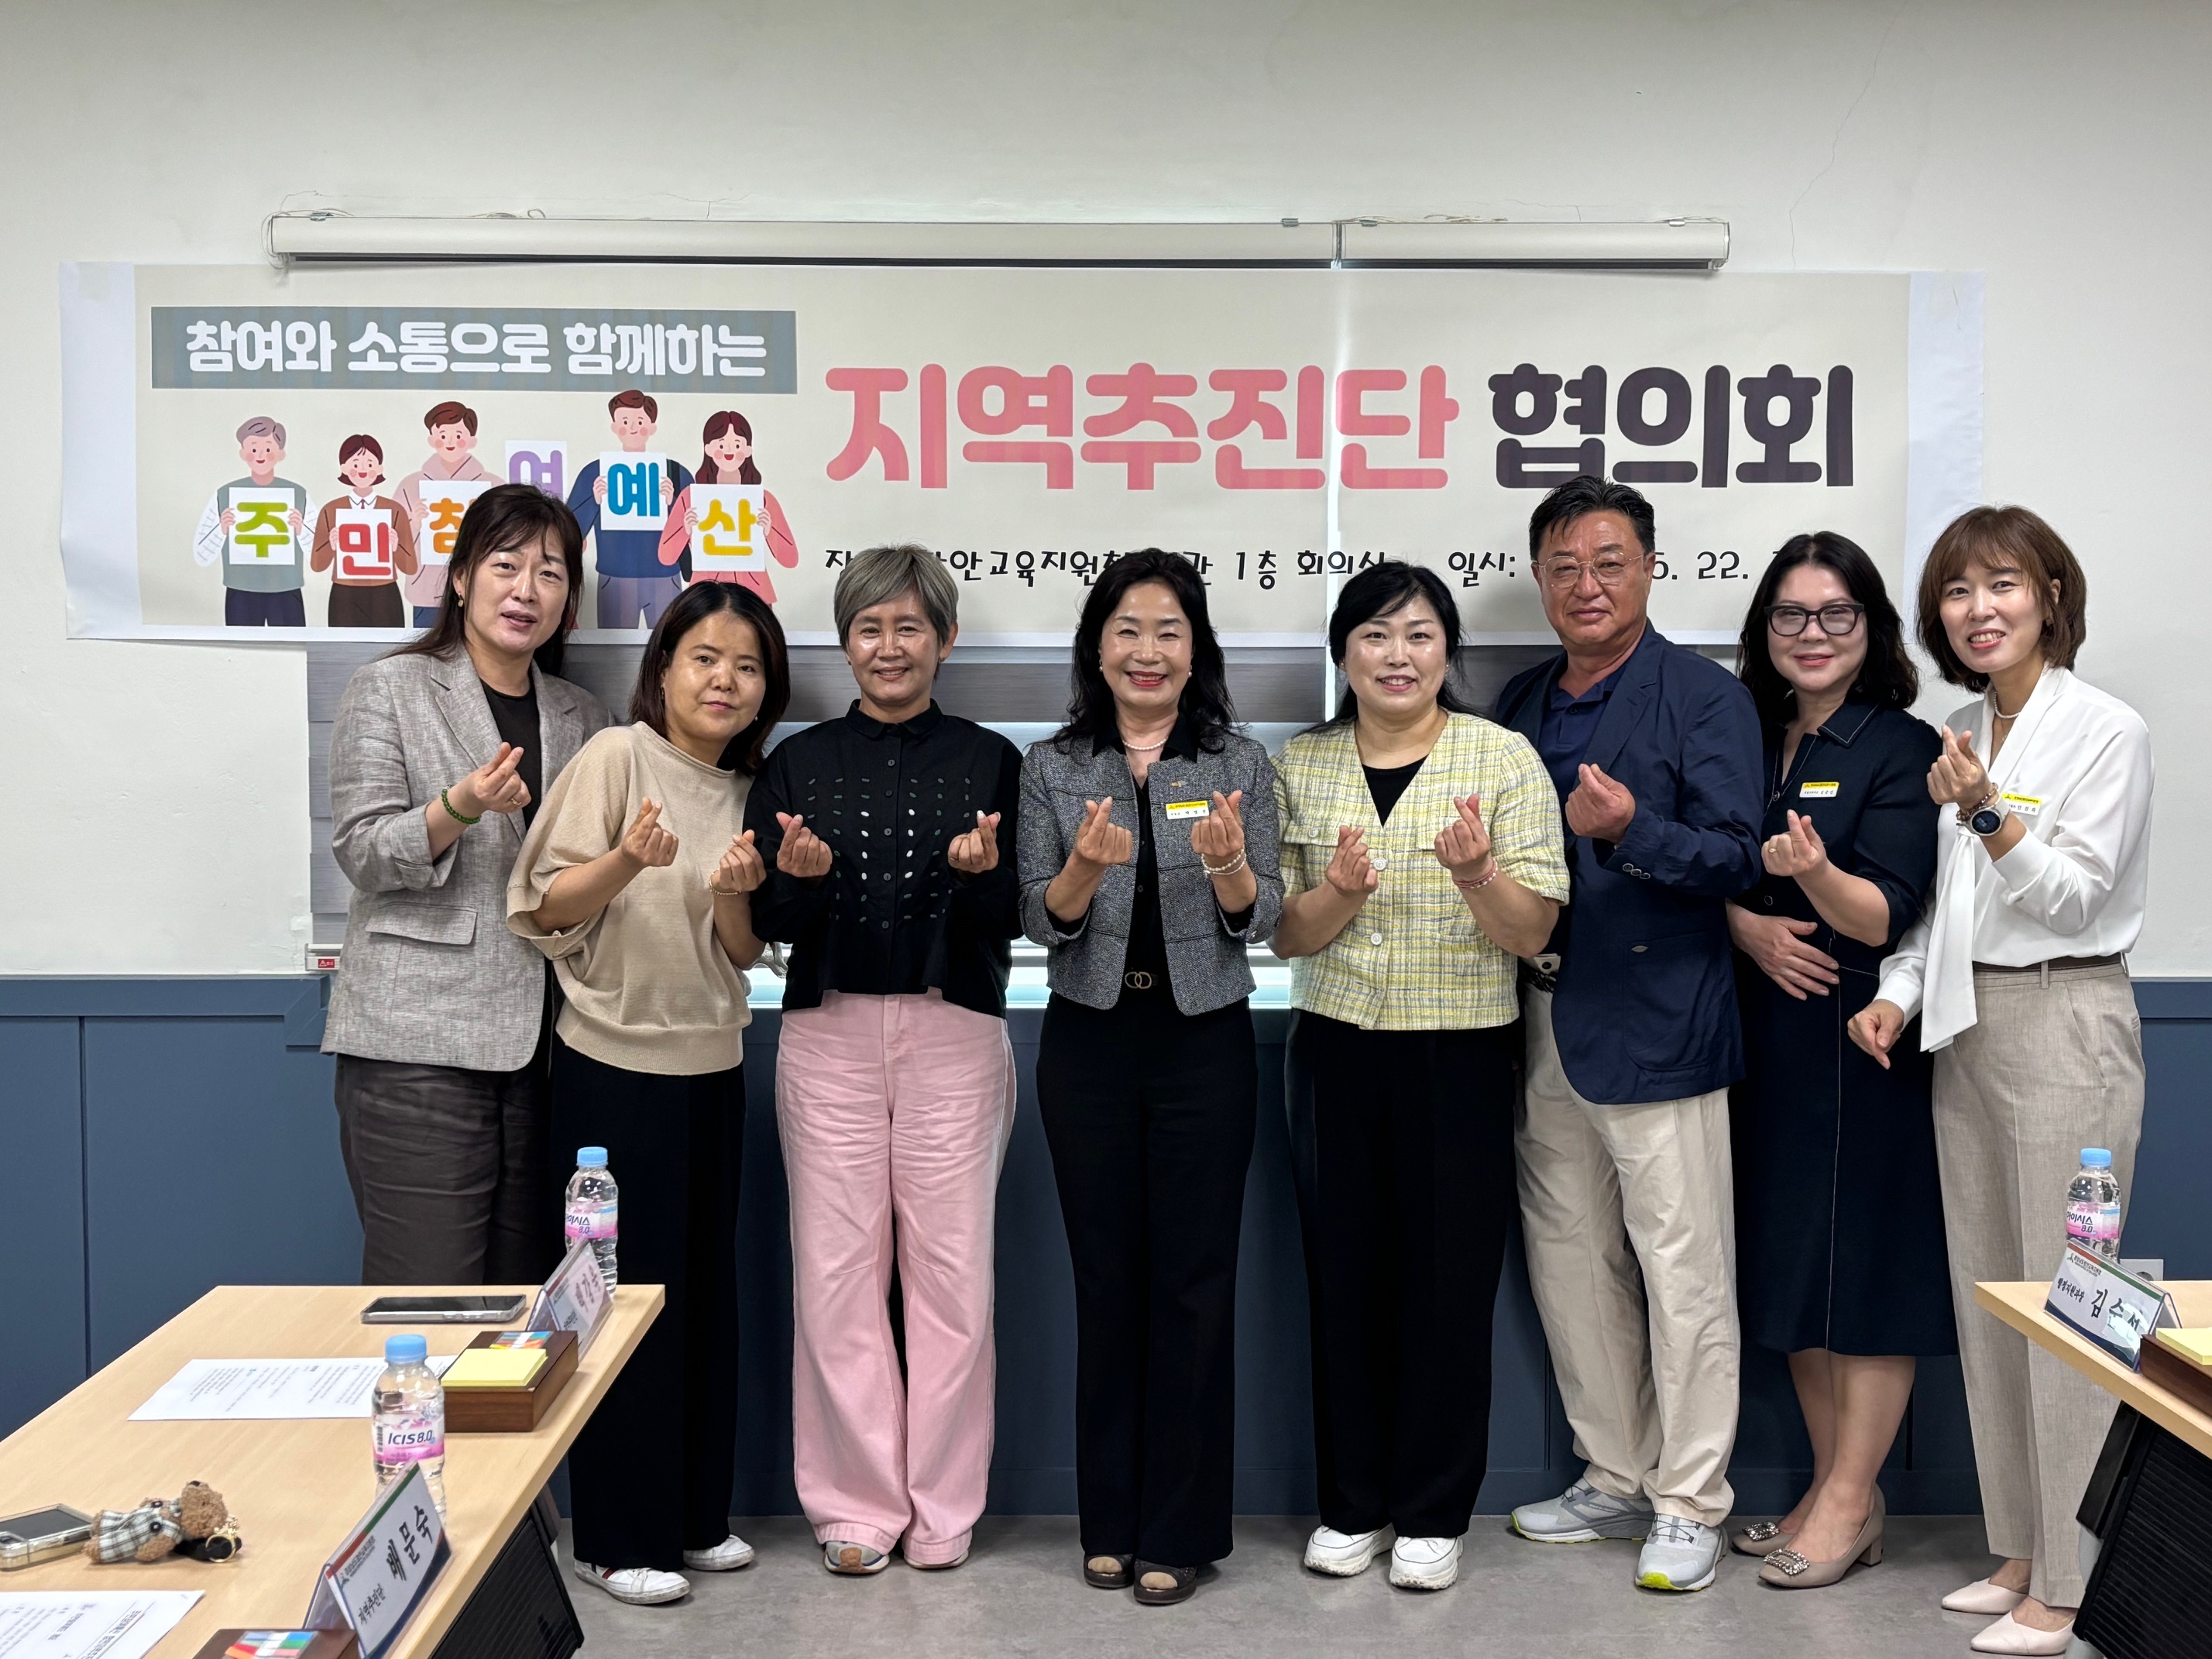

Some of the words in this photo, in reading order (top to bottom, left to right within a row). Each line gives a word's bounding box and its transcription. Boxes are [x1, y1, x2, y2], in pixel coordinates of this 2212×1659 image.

[186, 320, 336, 373] 참여와
[347, 321, 551, 375] 소통으로
[565, 322, 767, 377] 함께하는
[825, 362, 1459, 490] 지역추진단
[1487, 362, 1854, 489] 협의회
[235, 501, 288, 558] 주
[338, 524, 390, 577] 민
[607, 462, 661, 518] 예
[698, 498, 757, 557] 산
[933, 550, 1126, 588] 안교육지원
[1448, 551, 1516, 588] 일시:
[1697, 551, 1749, 580] 22.
[386, 1504, 434, 1582] 배문숙
